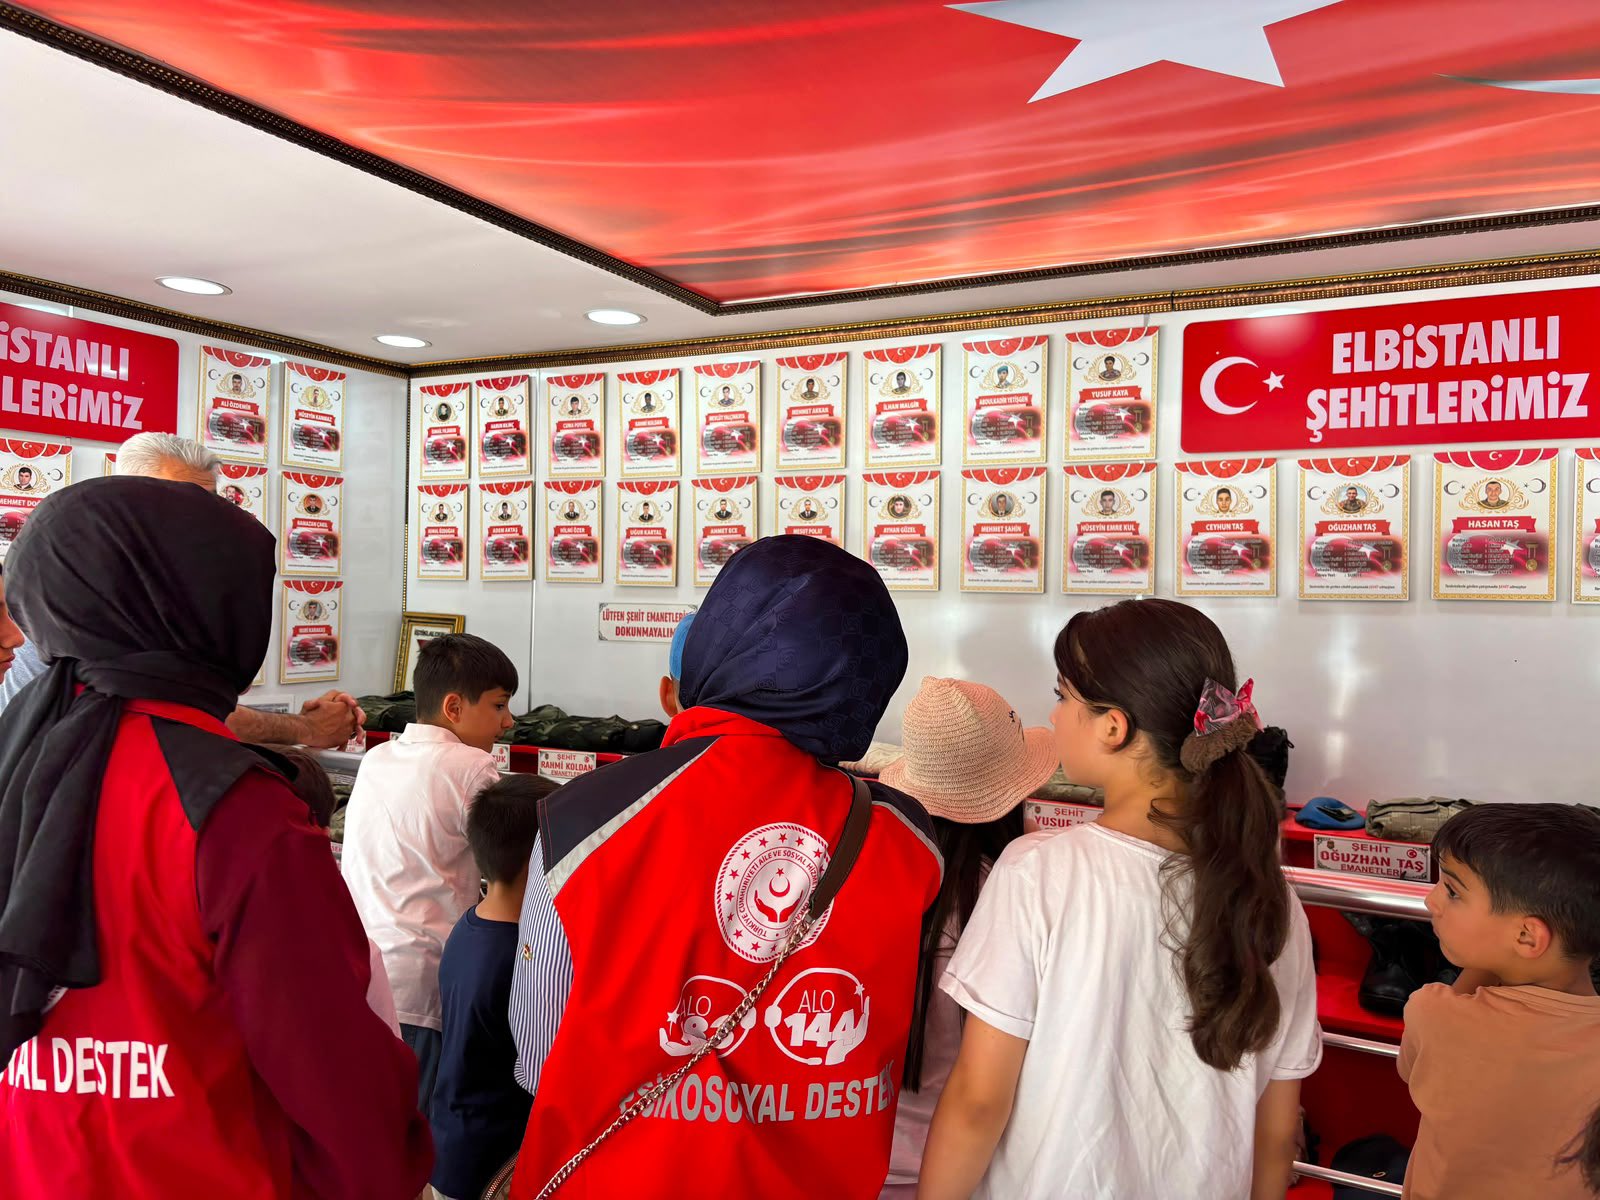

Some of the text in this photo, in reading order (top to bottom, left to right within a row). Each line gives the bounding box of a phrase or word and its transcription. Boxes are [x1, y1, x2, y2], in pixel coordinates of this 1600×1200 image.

[1091, 389, 1129, 399] YUSUF KAYA
[1004, 525, 1021, 533] ŞAHİN
[1081, 523, 1106, 532] HÜSEYİN
[1206, 523, 1244, 531] CEYHUN TAŞ
[1328, 522, 1376, 532] OĞUZHAN TAŞ
[1468, 520, 1519, 529] HASAN TAŞ
[603, 609, 625, 621] LÜTFEN
[627, 609, 645, 624] ŞEHİT
[541, 761, 593, 772] RAHMİ KOLDAN
[1054, 808, 1085, 817] ŞEHİT
[1034, 815, 1072, 828] YUSUF
[773, 850, 783, 858] VE
[1351, 842, 1391, 854] ŞEHİT
[758, 853, 773, 866] AİLE
[783, 850, 807, 866] SOSYAL
[1320, 848, 1424, 872] OĞUZHAN TAŞ
[738, 863, 759, 913] CUMHURİYETİ
[742, 914, 768, 939] TÜRKİYE
[680, 996, 711, 1017] ALO
[799, 989, 836, 1013] ALO
[784, 1008, 856, 1048] 144
[52, 1037, 175, 1099] DESTEK
[805, 1060, 895, 1120] DESTEK
